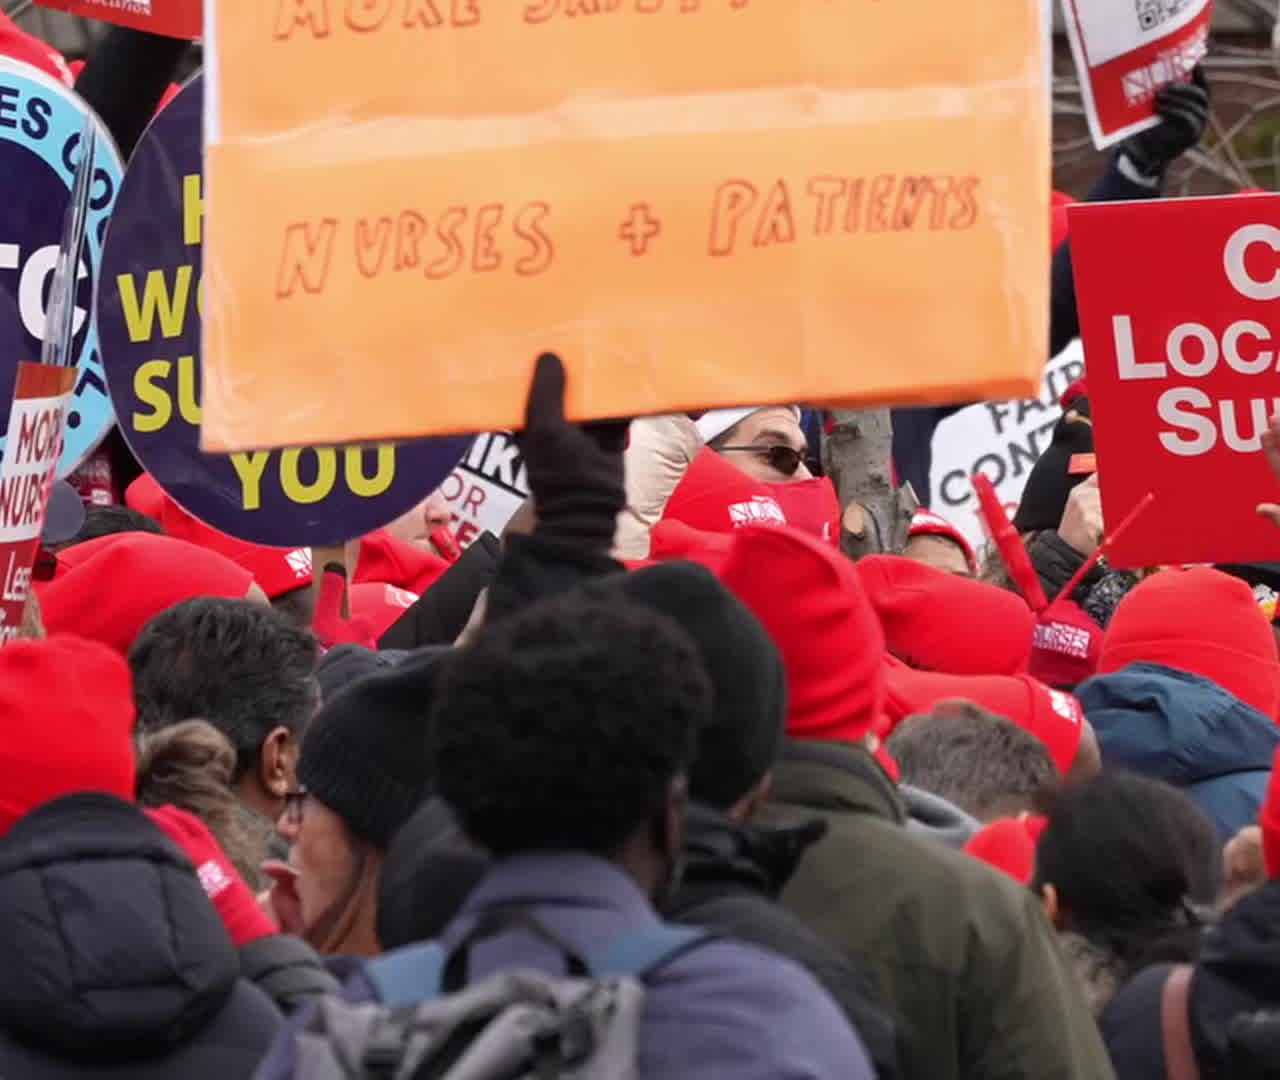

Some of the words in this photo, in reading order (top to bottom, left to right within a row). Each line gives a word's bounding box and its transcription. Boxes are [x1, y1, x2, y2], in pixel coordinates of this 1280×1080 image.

[273, 199, 556, 300] NURSES
[708, 174, 981, 259] PATIENTS
[228, 440, 397, 512] YOU
